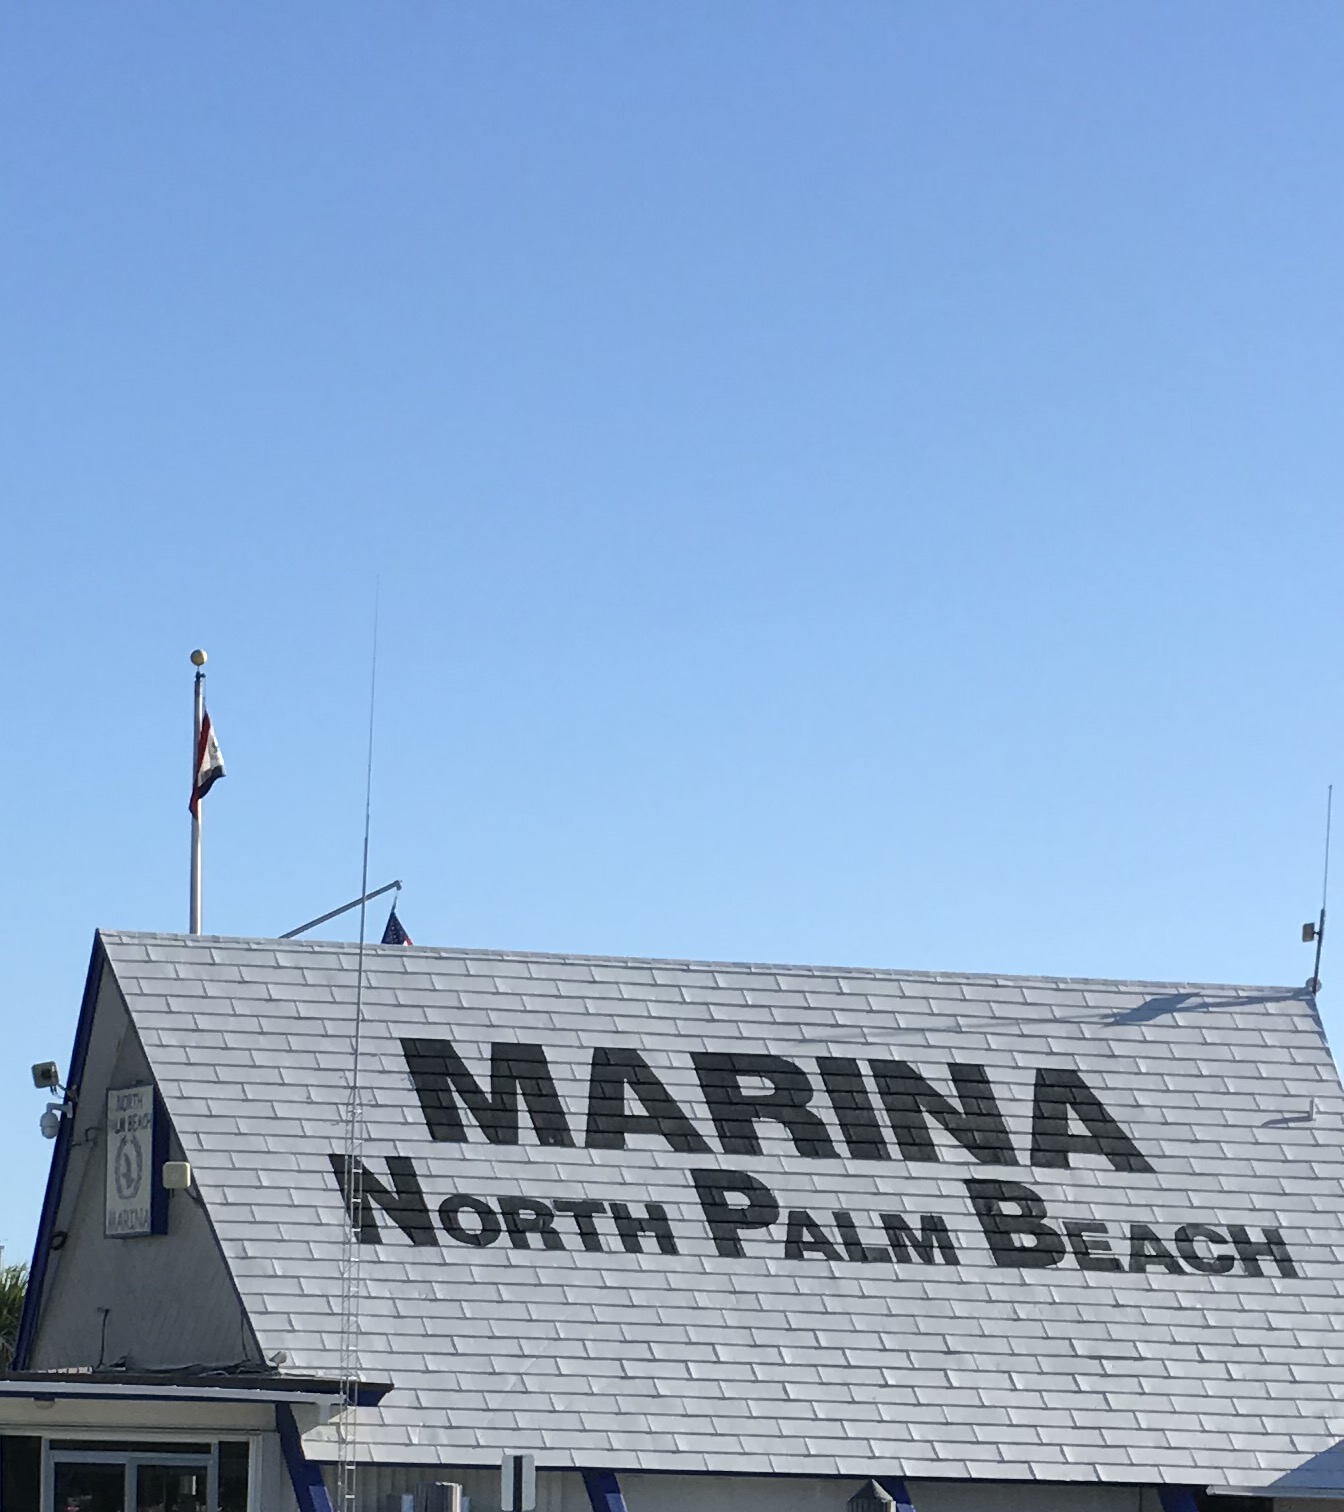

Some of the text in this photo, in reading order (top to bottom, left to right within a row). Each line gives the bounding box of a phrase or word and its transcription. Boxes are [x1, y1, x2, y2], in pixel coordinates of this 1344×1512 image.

[399, 1037, 1157, 1173] MARINA
[328, 1153, 1299, 1278] NORTH PALM BEACH
